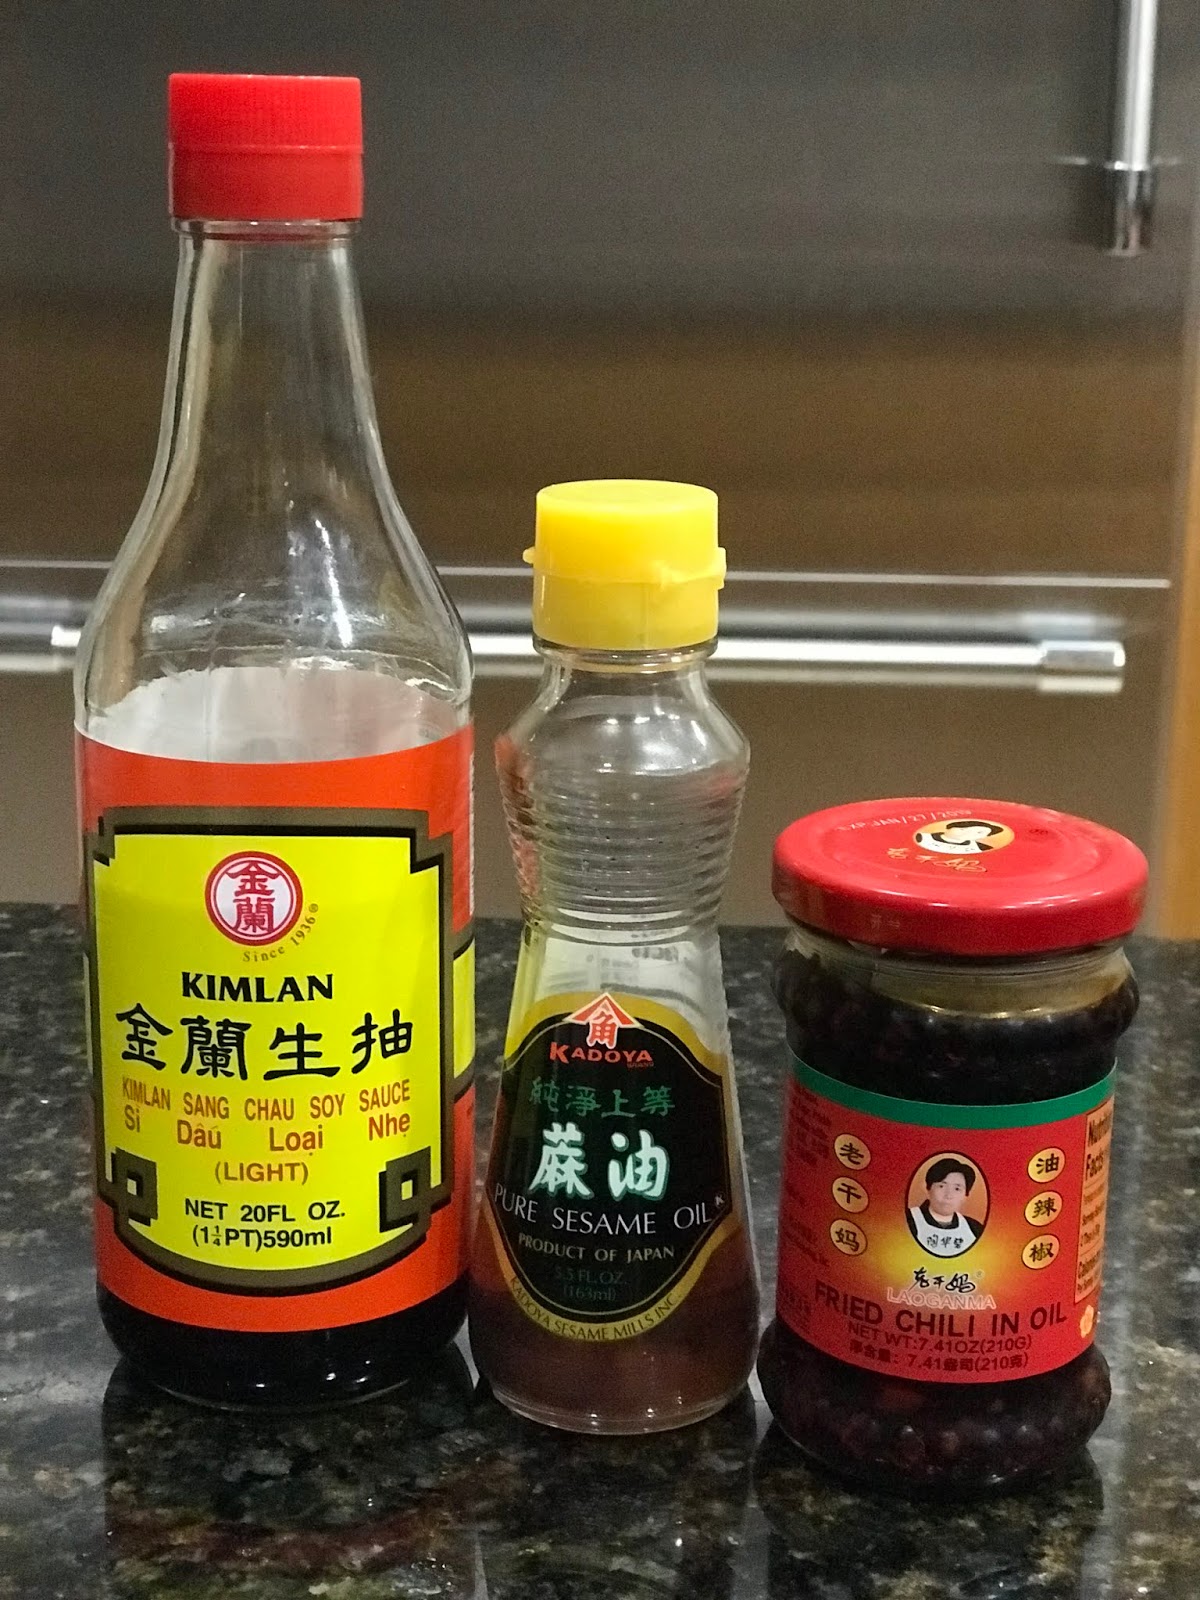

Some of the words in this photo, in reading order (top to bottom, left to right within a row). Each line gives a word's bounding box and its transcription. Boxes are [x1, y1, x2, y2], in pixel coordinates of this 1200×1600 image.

[225, 862, 281, 932] 金蘭
[242, 945, 285, 963] Since
[181, 971, 334, 1002] KIMLAN
[115, 1002, 414, 1081] 金蘭生抽
[550, 1041, 653, 1064] KADOYA
[122, 1077, 171, 1111] KIMLAN
[183, 1092, 230, 1121] SANG
[244, 1097, 295, 1121] CHAU
[310, 1094, 346, 1117] SOY
[359, 1078, 411, 1112] SAUCE
[124, 1105, 141, 1133] Si
[214, 1161, 309, 1185] (LIGHT)
[184, 1198, 229, 1221] NET
[240, 1204, 296, 1223] 20FL
[308, 1200, 346, 1218] OZ.
[494, 1183, 539, 1223] PURE
[551, 1207, 657, 1235] SESAME
[673, 1202, 712, 1229] OIL
[518, 1232, 585, 1260] PRODUCT
[594, 1248, 617, 1261] OF
[626, 1245, 675, 1264] JAPAN
[510, 1276, 552, 1327] KADOYA
[554, 1320, 609, 1341] SESAME
[613, 1316, 656, 1340] MILLS
[814, 1278, 884, 1325] FRIED
[895, 1308, 976, 1338] CHILI
[991, 1311, 1020, 1336] IN
[1028, 1302, 1068, 1330] OIL
[886, 1286, 997, 1310] LAOGANMA
[848, 1323, 885, 1342] NET
